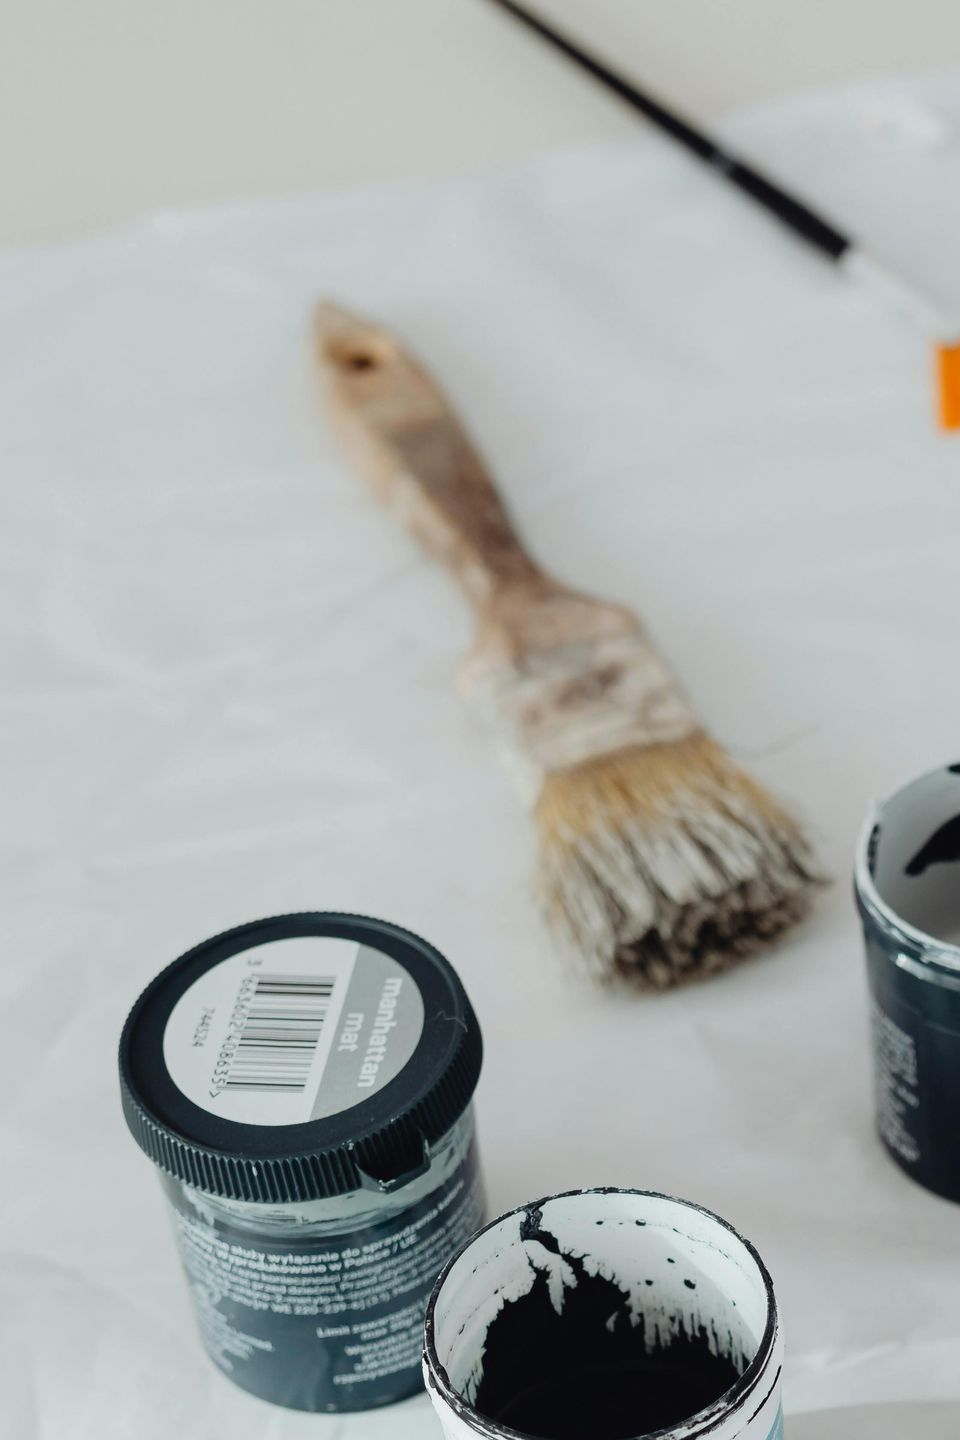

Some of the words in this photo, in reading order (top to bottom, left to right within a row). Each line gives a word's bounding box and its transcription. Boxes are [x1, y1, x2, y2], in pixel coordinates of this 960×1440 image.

[337, 1011, 364, 1053] mat
[357, 978, 403, 1088] manhattan
[341, 1248, 359, 1258] do
